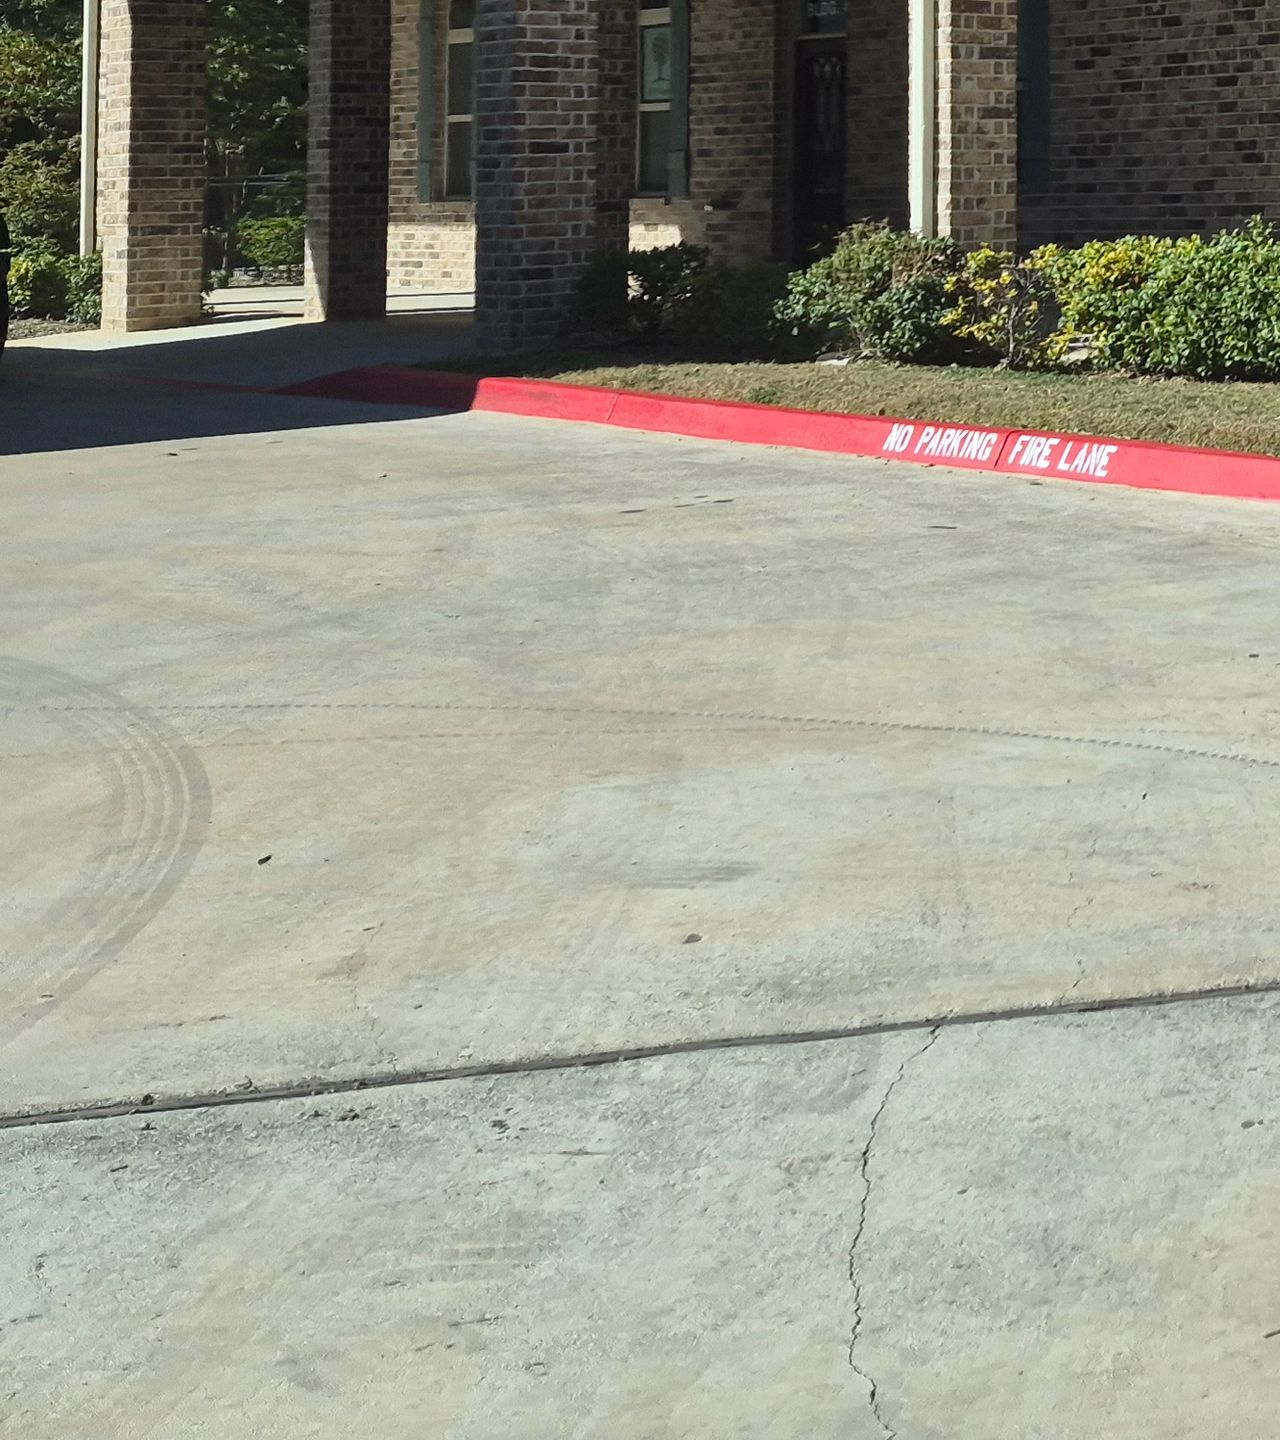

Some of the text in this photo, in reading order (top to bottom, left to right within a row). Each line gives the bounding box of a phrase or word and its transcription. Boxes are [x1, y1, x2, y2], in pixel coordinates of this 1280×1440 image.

[882, 423, 1119, 478] NO PARKING FIRE LANE
